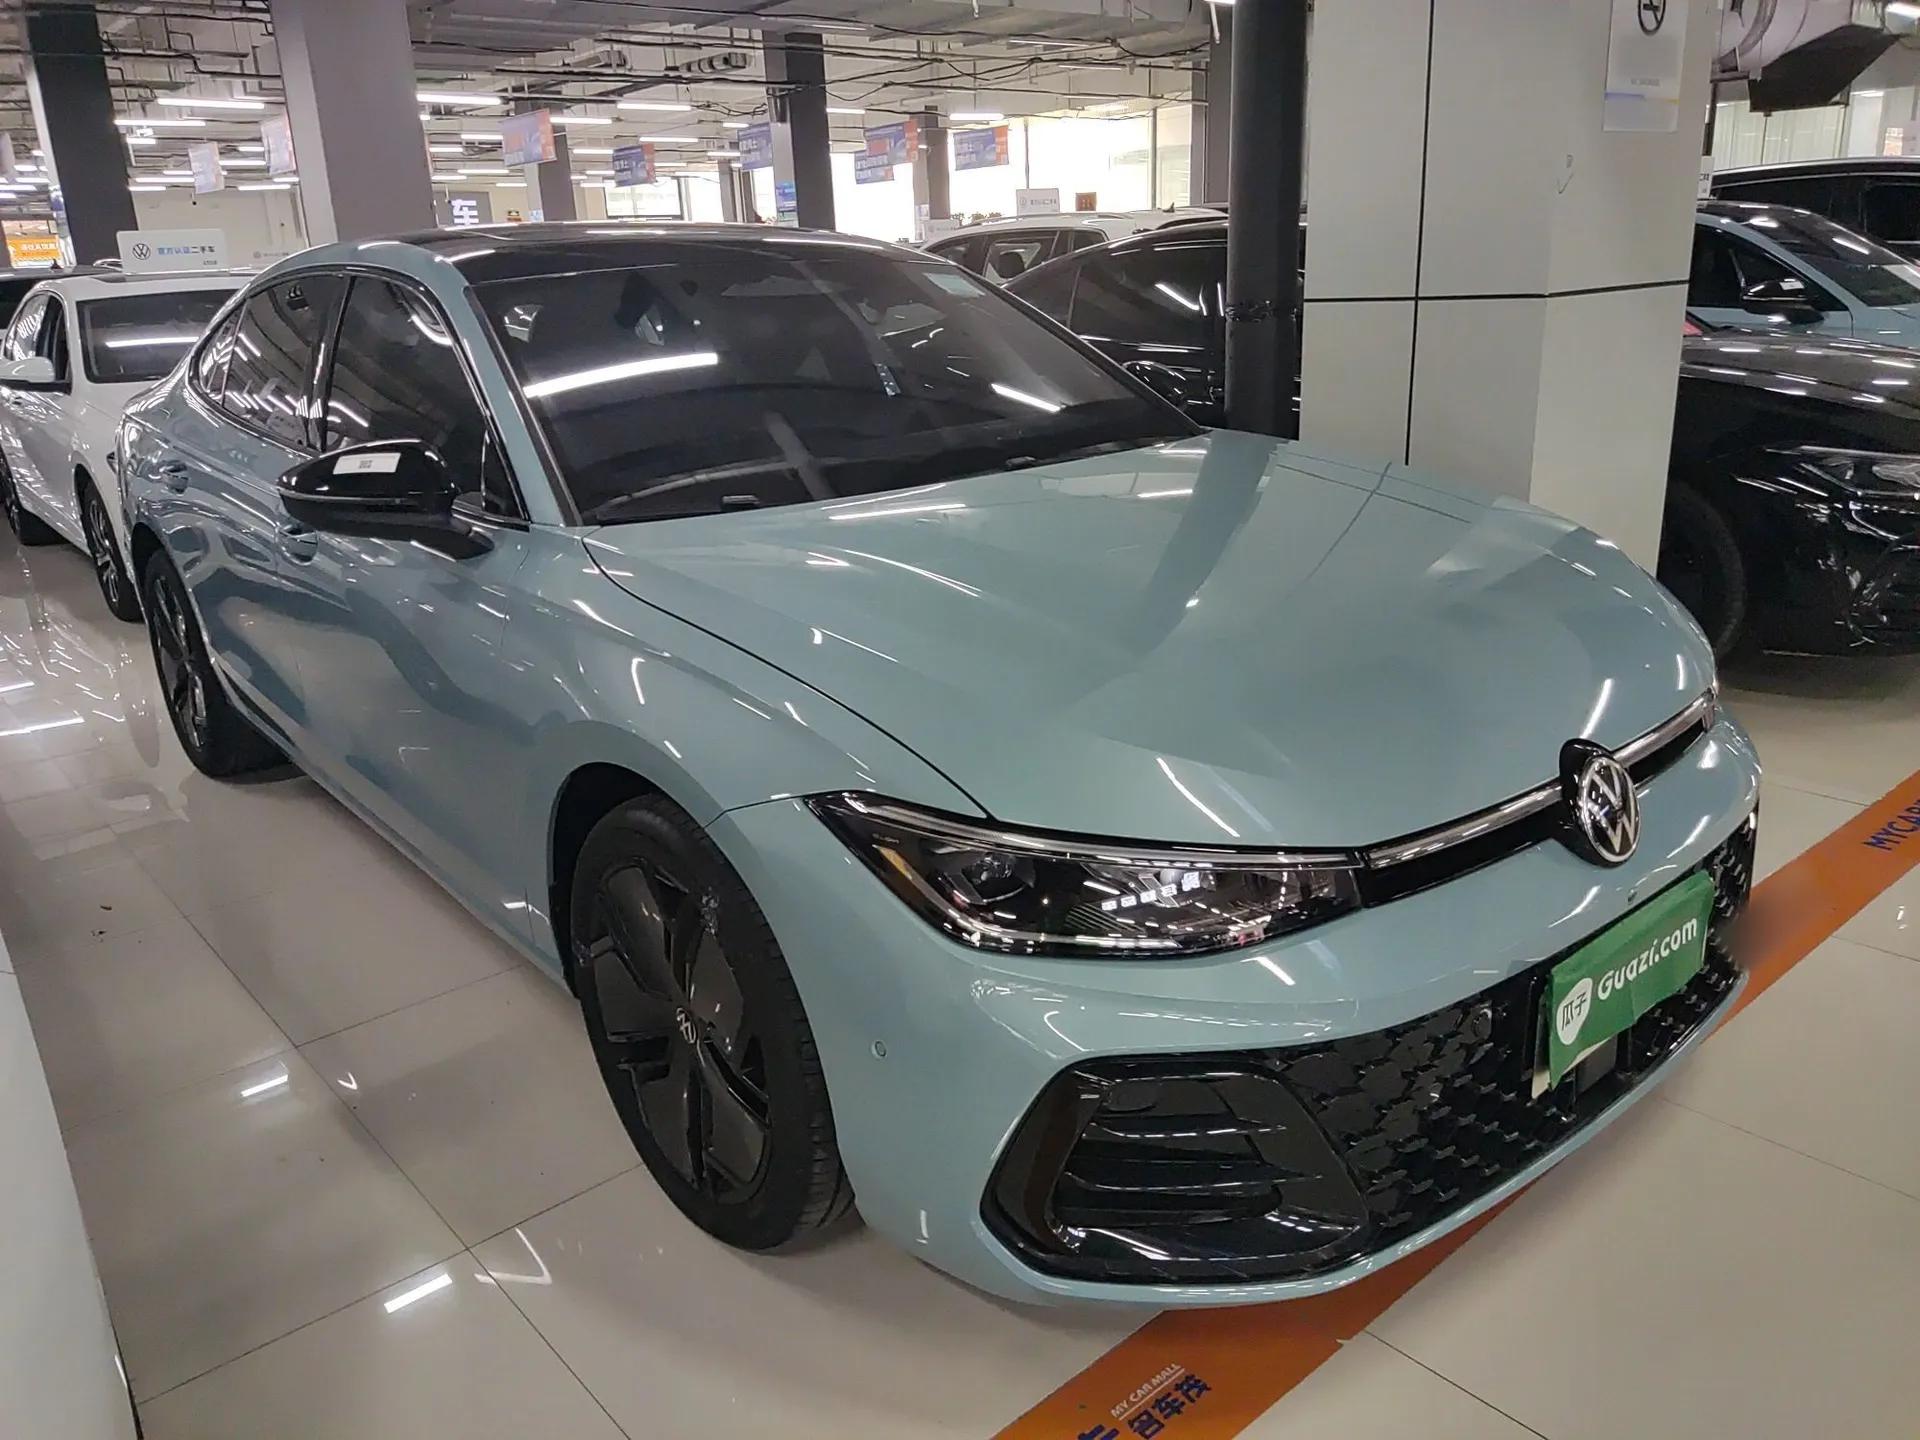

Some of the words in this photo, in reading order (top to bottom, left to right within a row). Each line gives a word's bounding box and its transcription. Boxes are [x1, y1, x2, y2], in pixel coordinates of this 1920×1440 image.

[1597, 917, 1698, 1001] Guazi.com
[1561, 991, 1587, 1032] 瓜子
[1110, 1398, 1129, 1419] MY
[1129, 1380, 1153, 1403] CAR
[1151, 1362, 1182, 1387] MALL
